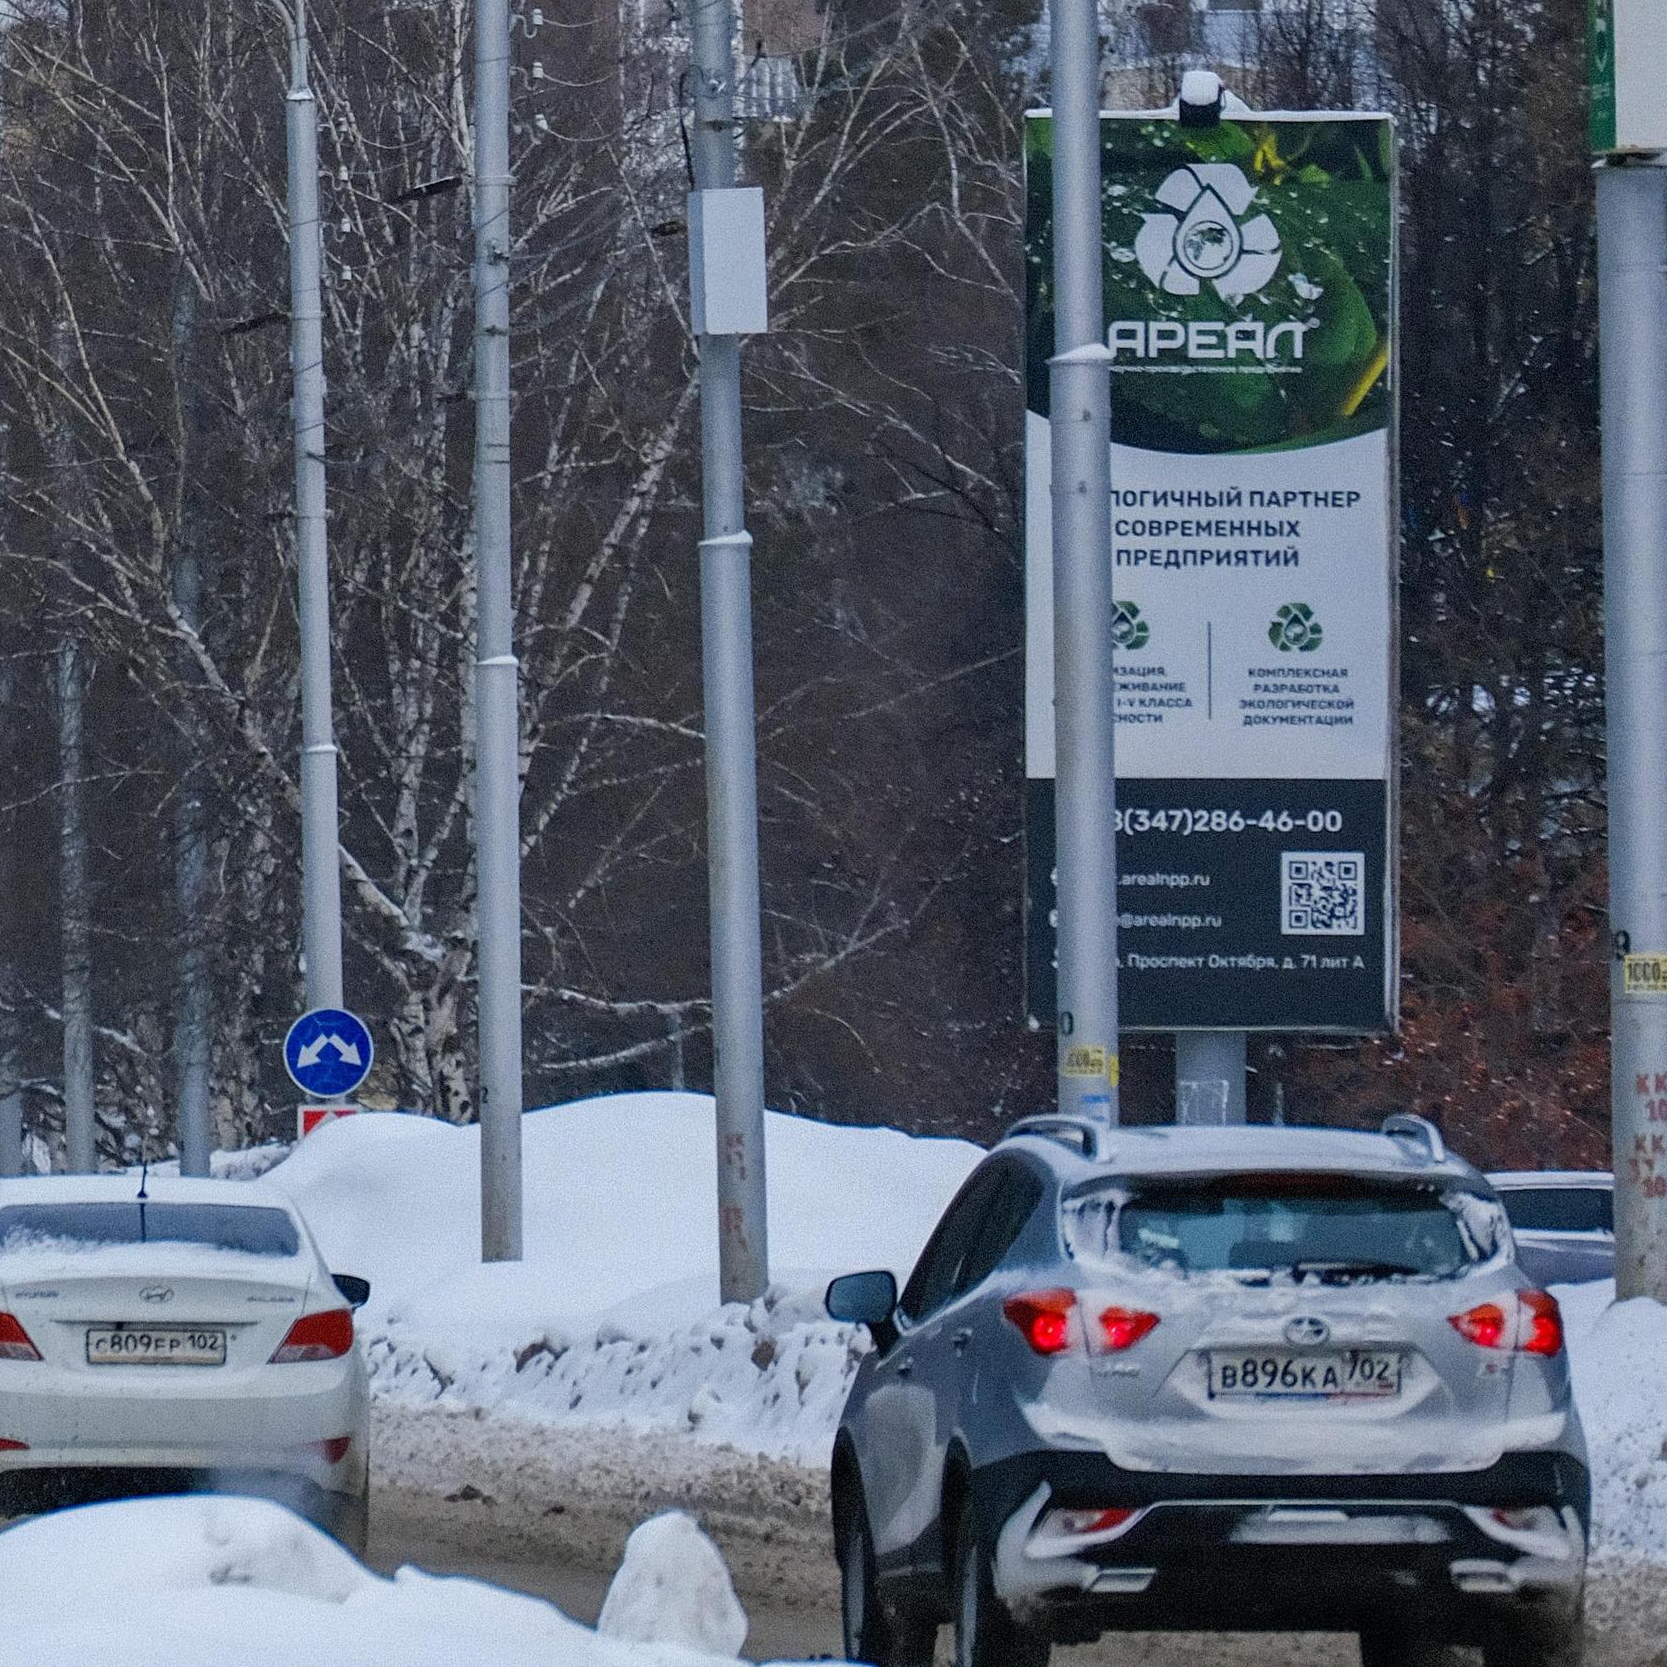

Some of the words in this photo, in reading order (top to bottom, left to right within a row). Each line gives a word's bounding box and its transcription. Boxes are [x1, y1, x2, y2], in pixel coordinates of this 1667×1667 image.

[1108, 320, 1304, 359] АРЕАЛ
[1111, 486, 1243, 508] ЛОГИЧНЫЙ
[1249, 489, 1361, 508] ПАРТНЕР
[1115, 519, 1301, 538] СОВРЕМЕННЫХ
[1116, 546, 1300, 569] ПРЕДПРИЯТИЙ
[1247, 668, 1349, 678] КОМПЛЕКСНАЯ
[1253, 683, 1340, 693] РАЗРАБОТКА
[1138, 697, 1193, 708] КЛАССА
[1239, 697, 1355, 710] ЭКОЛОГИЧЕСКОЙ
[1243, 715, 1353, 727] ДОКУМЕНТАЦИИ
[1128, 953, 1204, 970] Проспект
[1300, 954, 1317, 969] 71
[1320, 957, 1349, 969] лит
[187, 1333, 219, 1351] 102
[1221, 1357, 1339, 1389] В896КА
